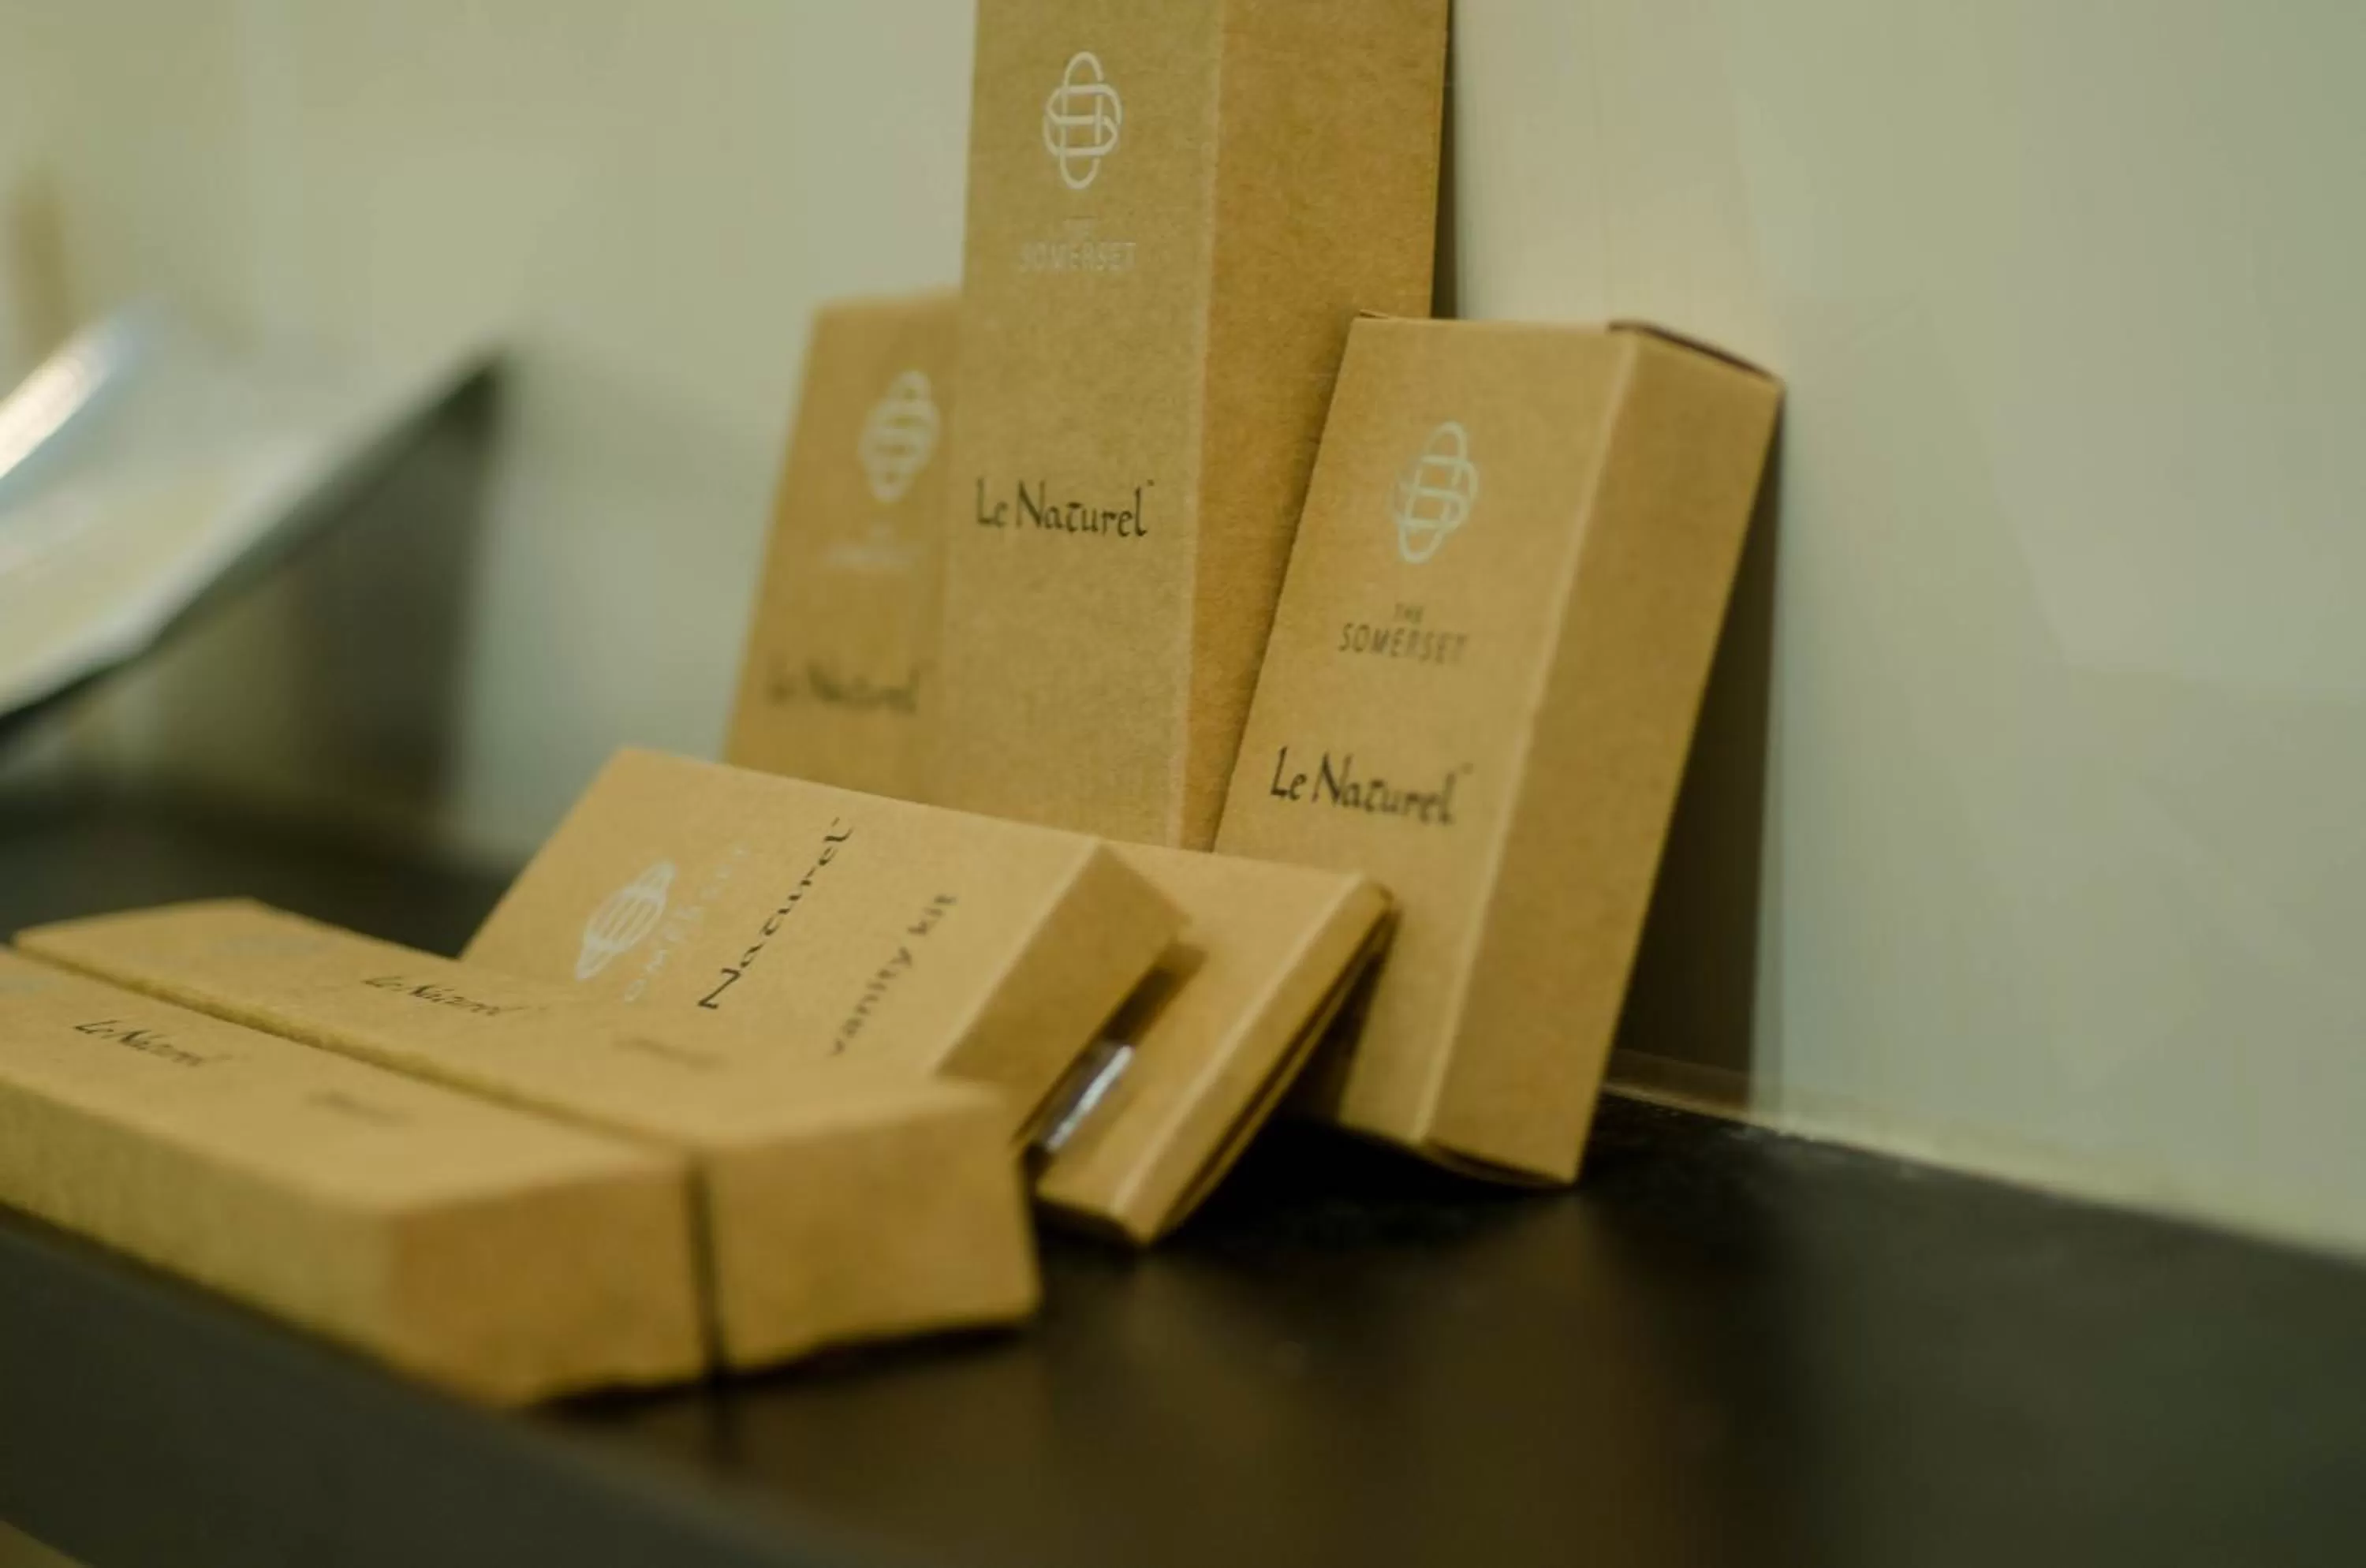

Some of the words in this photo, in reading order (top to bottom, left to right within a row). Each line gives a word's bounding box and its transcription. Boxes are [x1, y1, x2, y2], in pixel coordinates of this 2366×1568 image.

[976, 477, 1009, 527] Le
[1016, 479, 1149, 537] Naturel
[1270, 746, 1308, 801] Le
[1311, 751, 1458, 826] Naturel
[697, 825, 854, 1010] Naturel
[827, 946, 913, 1057] vanity
[907, 893, 958, 937] kit
